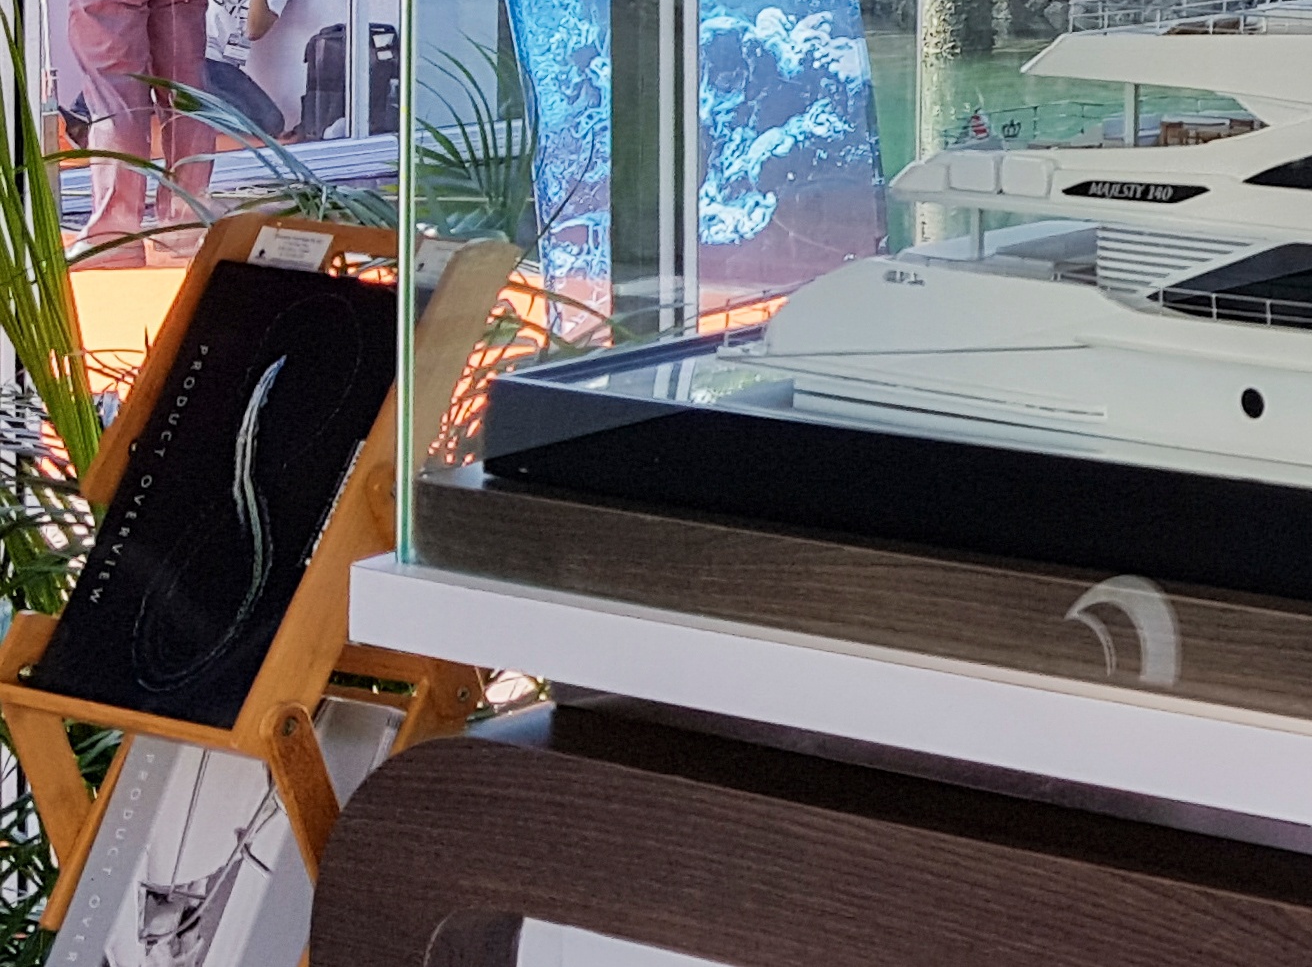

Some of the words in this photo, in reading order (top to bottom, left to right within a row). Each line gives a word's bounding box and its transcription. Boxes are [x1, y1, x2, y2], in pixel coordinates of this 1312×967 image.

[1088, 182, 1145, 199] MAJESTY
[1146, 185, 1174, 201] 140
[154, 344, 209, 458] PRODUCT
[89, 474, 152, 605] OVERVIEW
